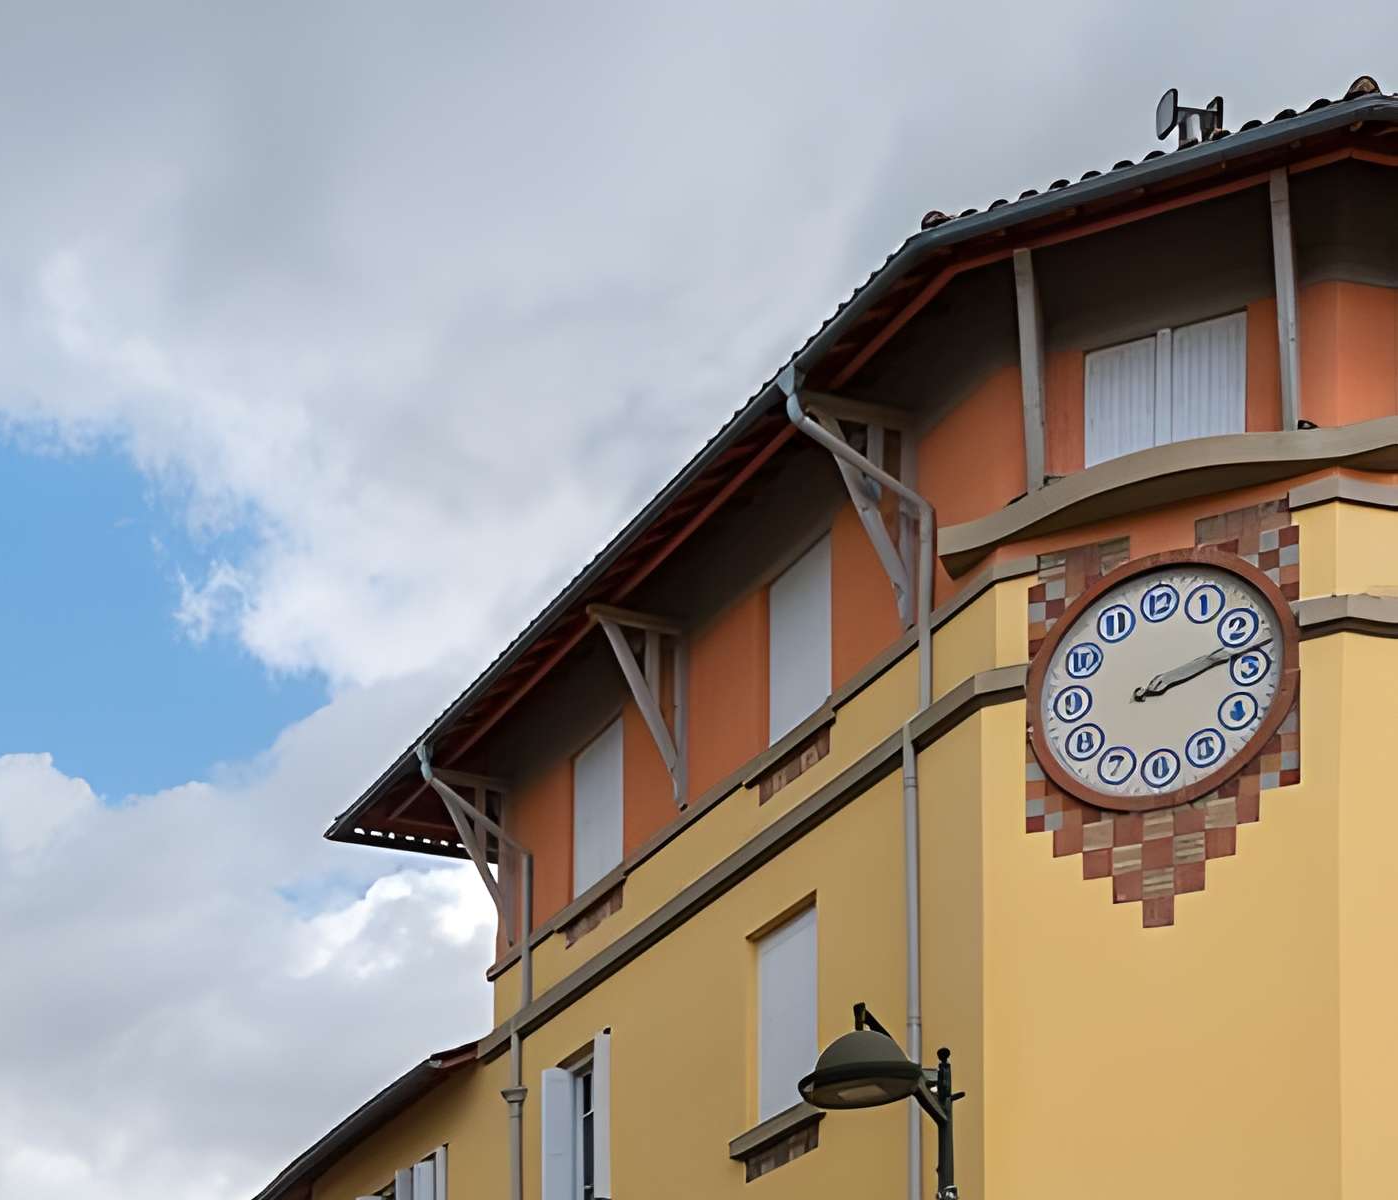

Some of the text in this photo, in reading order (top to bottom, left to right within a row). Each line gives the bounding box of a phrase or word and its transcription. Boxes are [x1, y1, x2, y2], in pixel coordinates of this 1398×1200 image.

[1149, 591, 1172, 616] 12
[1198, 592, 1208, 617] 1
[1106, 612, 1126, 637] 11
[1228, 616, 1247, 640] 2
[1240, 655, 1260, 680] 3
[1107, 755, 1126, 777] 7
